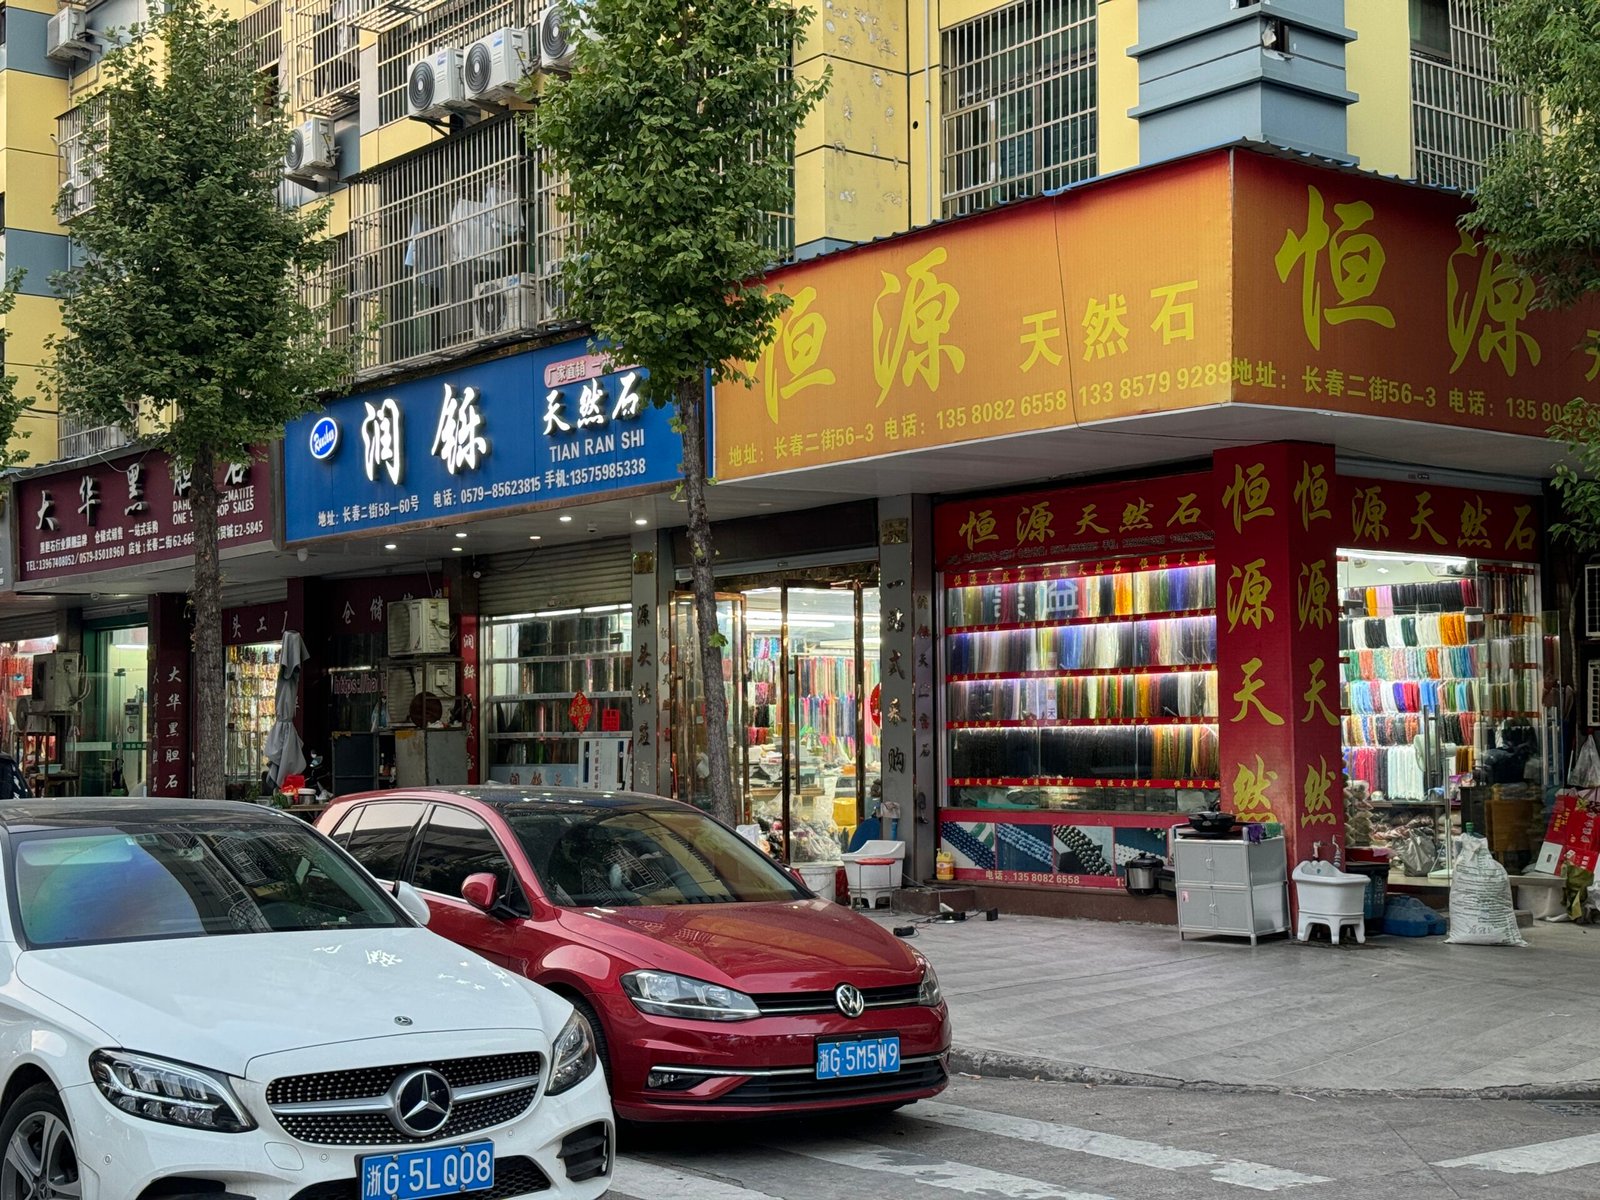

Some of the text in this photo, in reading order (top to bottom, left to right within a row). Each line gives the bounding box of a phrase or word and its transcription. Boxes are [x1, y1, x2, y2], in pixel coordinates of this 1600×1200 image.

[1018, 279, 1199, 372] 天然石
[543, 371, 639, 435] 天然石
[549, 428, 645, 463] TIAN RAN SHI
[173, 513, 187, 525] ONE
[232, 498, 255, 514] SALES
[958, 492, 1202, 551] 恒源天然石
[165, 665, 183, 790] 大华黑胆石
